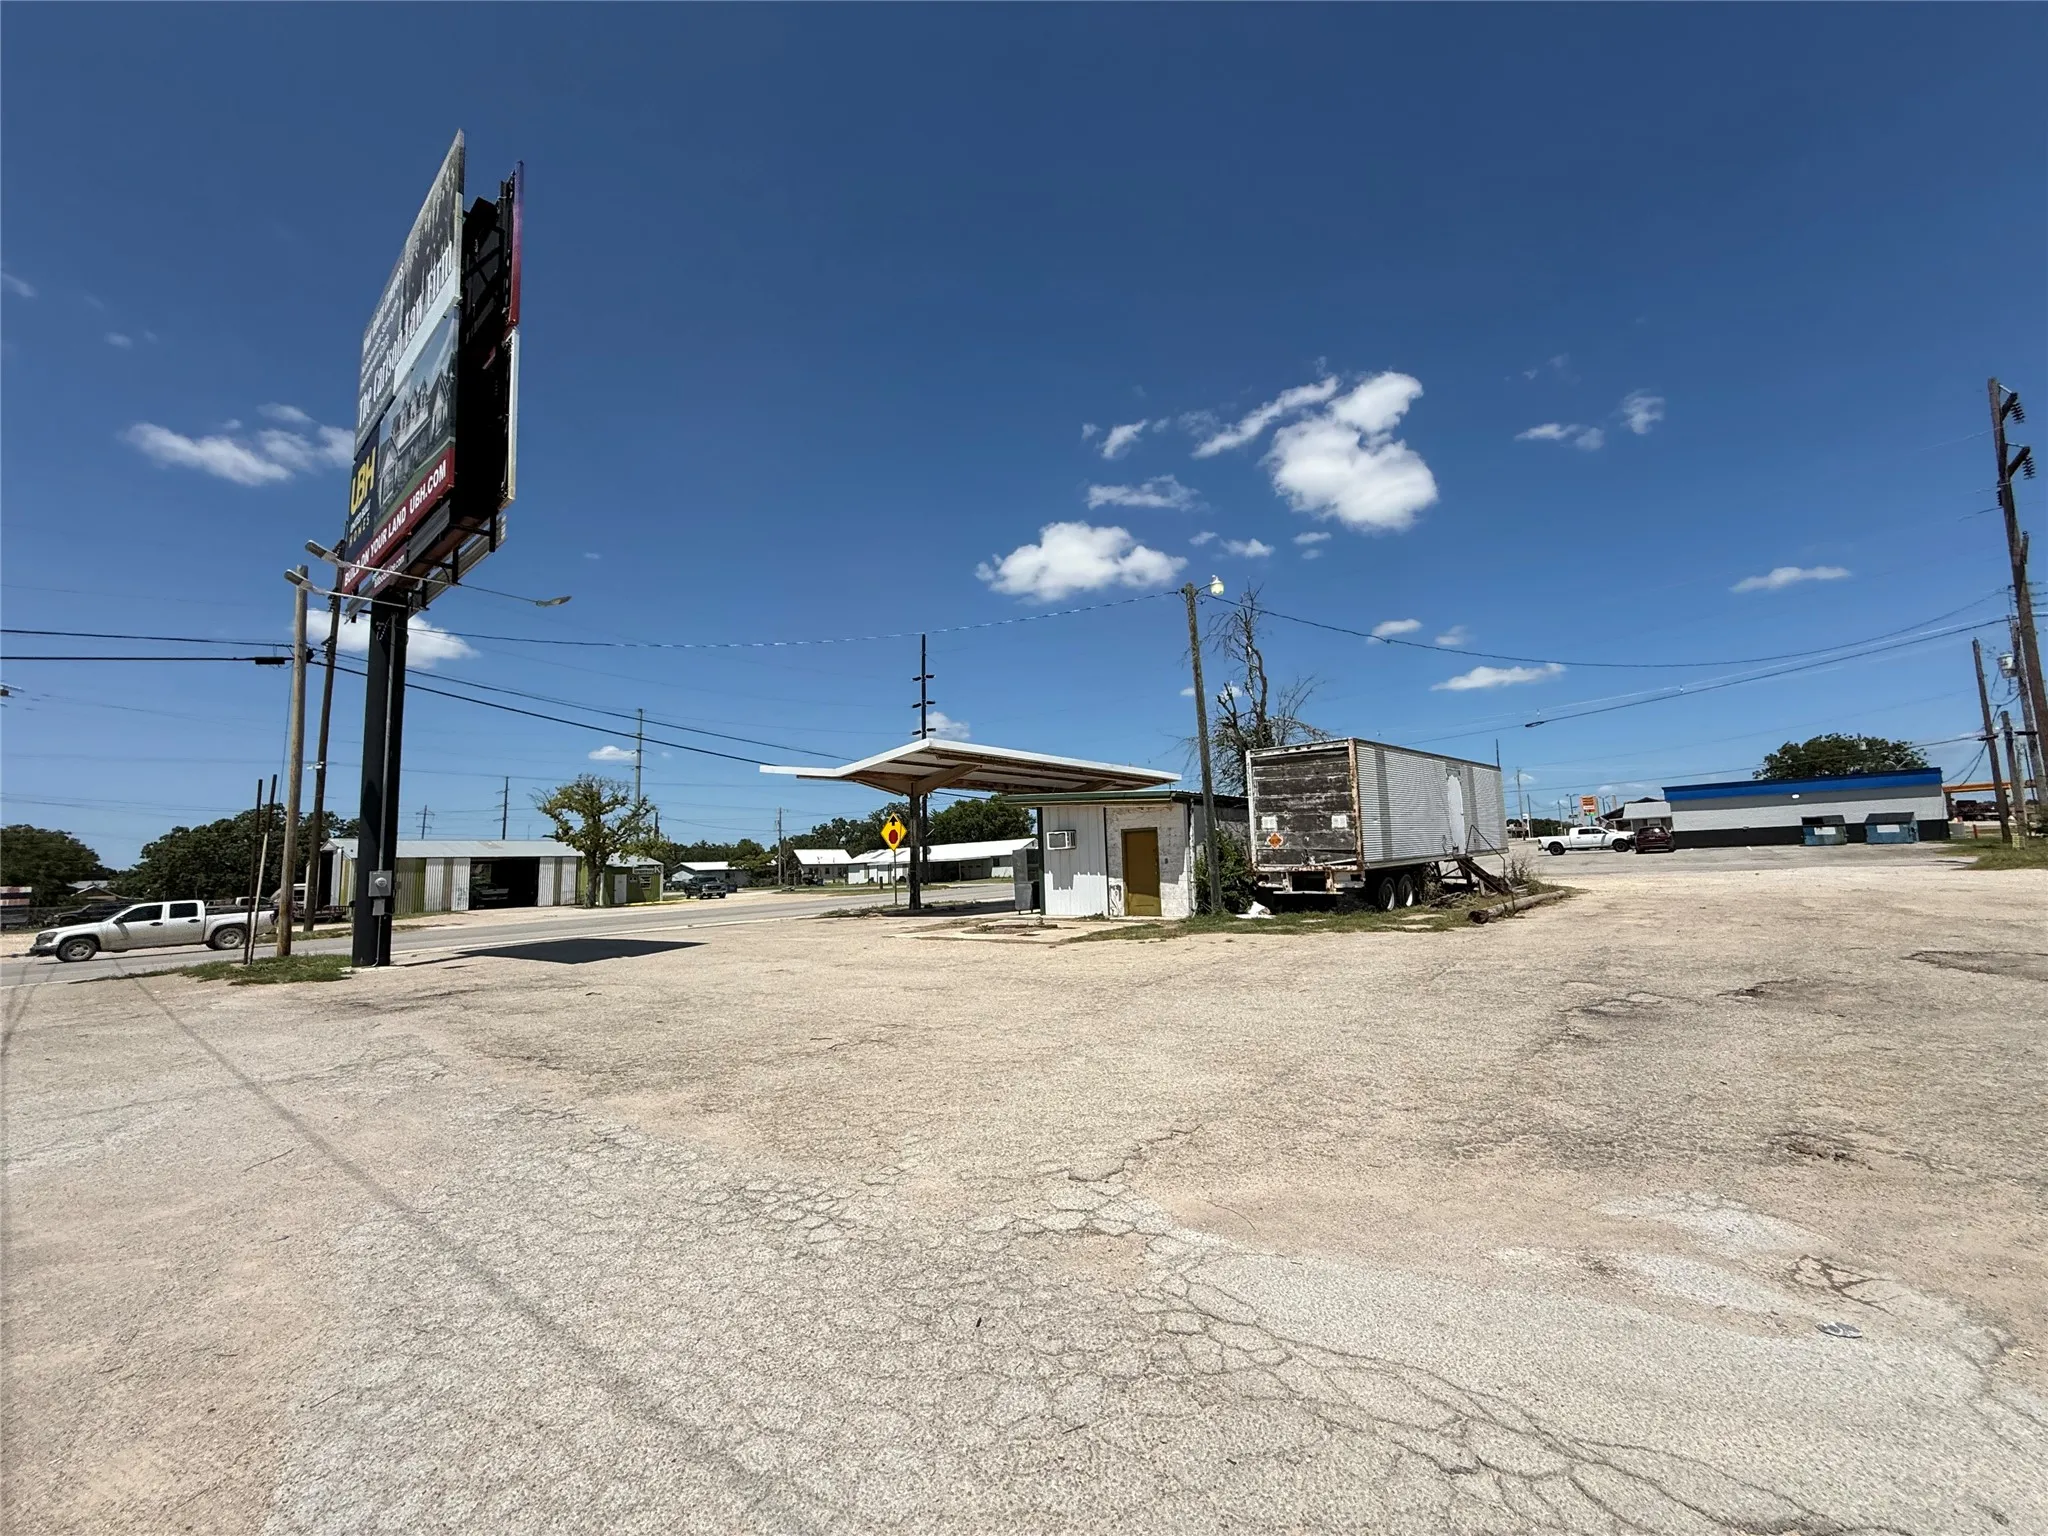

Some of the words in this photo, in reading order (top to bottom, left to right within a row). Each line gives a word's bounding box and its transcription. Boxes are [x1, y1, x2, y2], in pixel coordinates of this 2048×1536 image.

[359, 386, 373, 428] The
[373, 330, 403, 402] Carlson
[405, 290, 425, 348] Law
[427, 241, 452, 310] Firm
[351, 447, 376, 515] UBH
[370, 528, 387, 557] YOUR
[388, 507, 406, 538] LAND
[410, 460, 446, 514] UBH.COM
